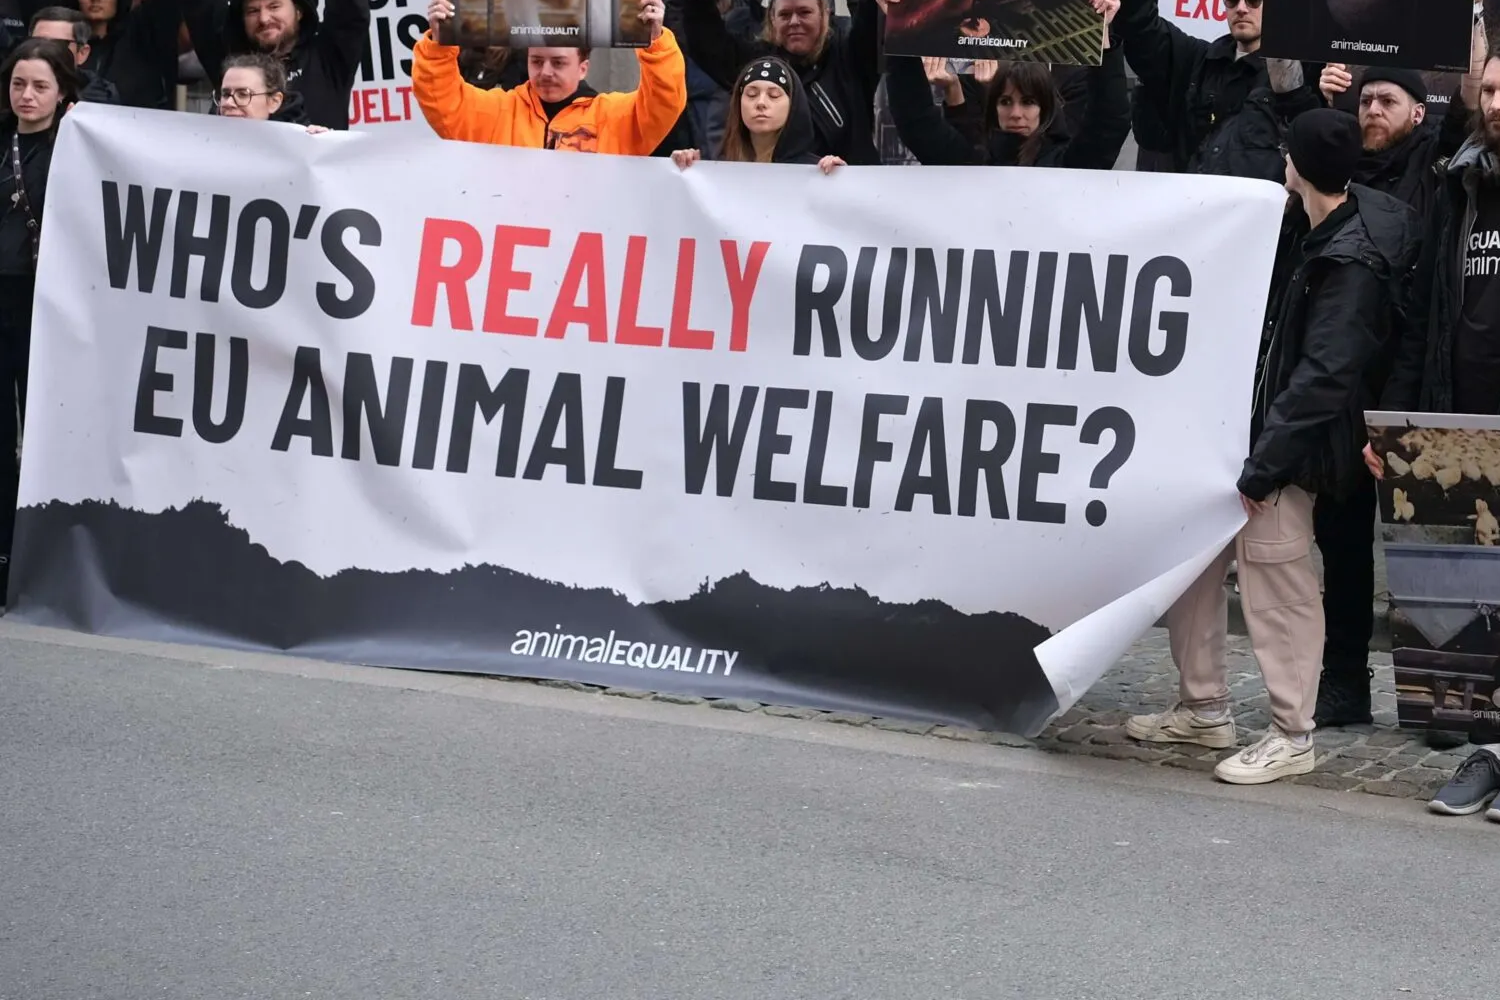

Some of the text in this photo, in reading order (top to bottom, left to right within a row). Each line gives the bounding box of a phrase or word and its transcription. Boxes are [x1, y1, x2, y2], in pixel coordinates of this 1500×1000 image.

[510, 24, 580, 37] animalEQUALITY
[958, 34, 1028, 48] animalEQUALITY
[1331, 38, 1399, 54] animalEQUALITY
[102, 180, 1193, 377] WHO'S REALLY RUNNING
[134, 325, 1136, 528] EU ANIMAL WELFARE?
[510, 622, 738, 677] animalEQUALITY
